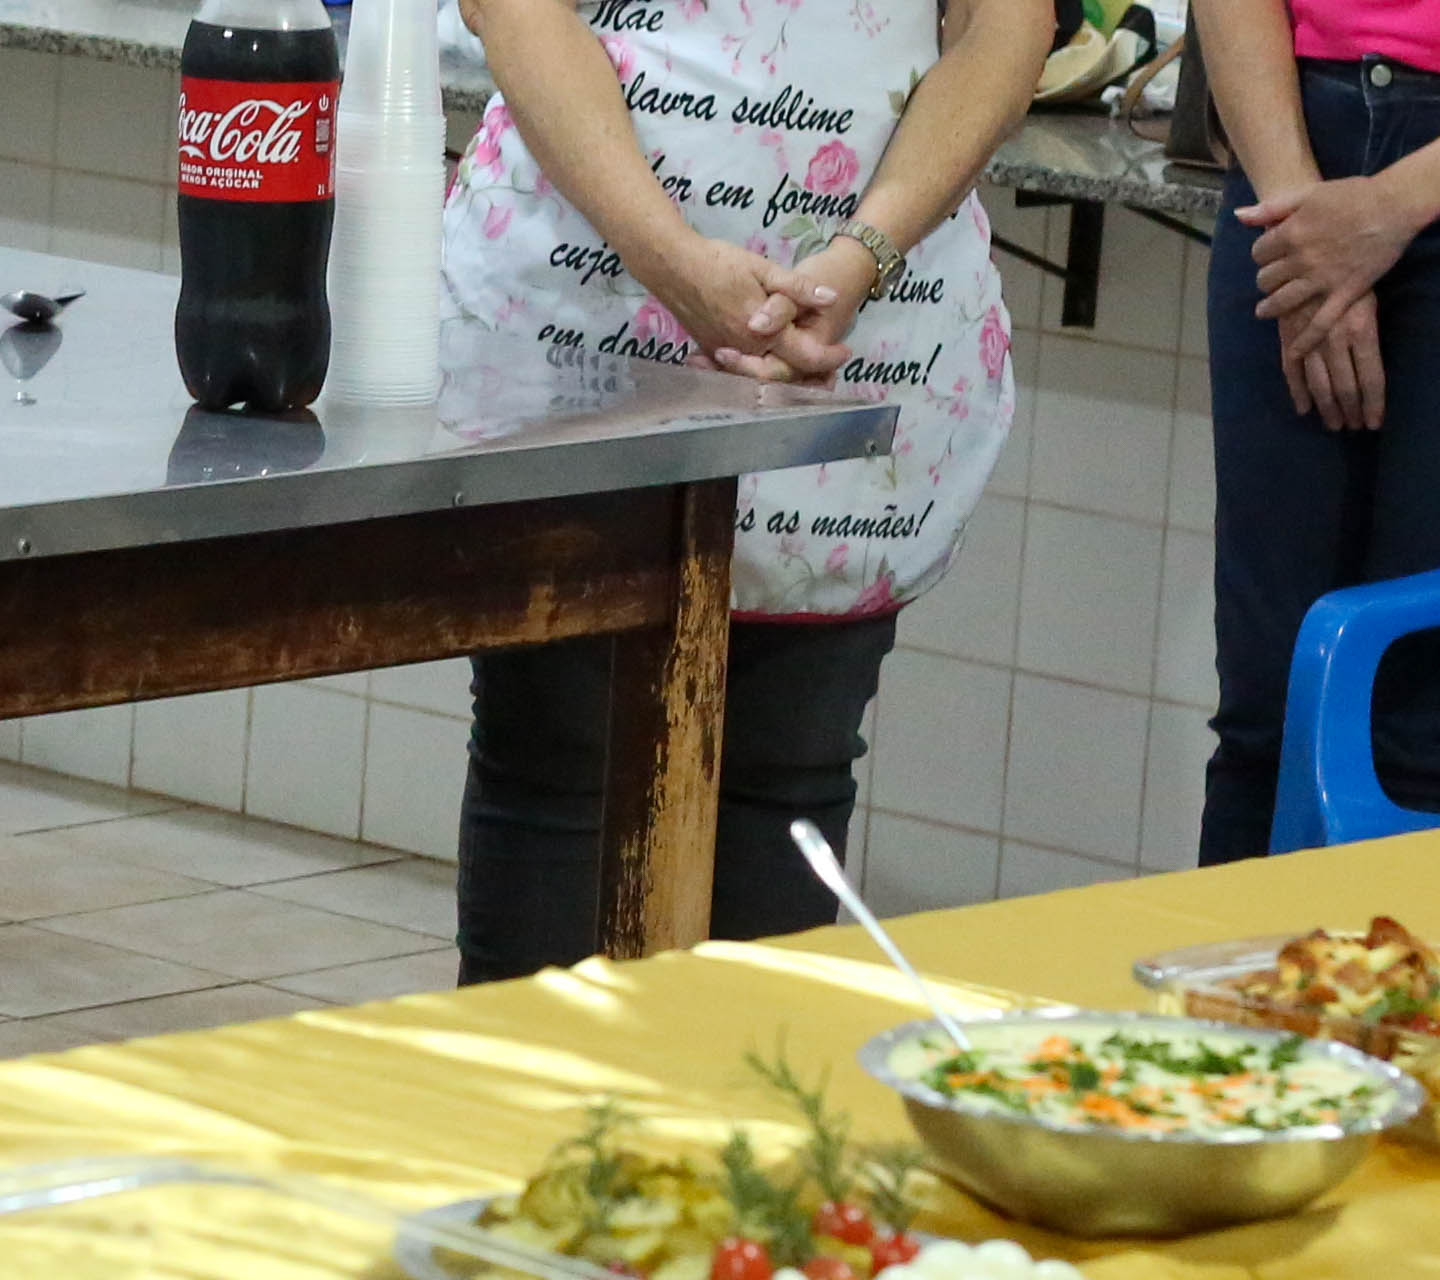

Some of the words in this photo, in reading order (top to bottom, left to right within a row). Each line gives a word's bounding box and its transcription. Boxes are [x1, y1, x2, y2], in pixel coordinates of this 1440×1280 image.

[621, 71, 718, 121] lavra
[732, 84, 854, 134] sublime
[206, 166, 263, 180] ORIGINAL
[210, 177, 260, 189] AÇÚCAR
[705, 179, 754, 210] em
[762, 172, 858, 228] forma
[549, 241, 624, 285] cuja
[598, 321, 690, 366] doses
[843, 342, 942, 386] amor!
[767, 507, 800, 535] as
[810, 499, 935, 539] mamães!
